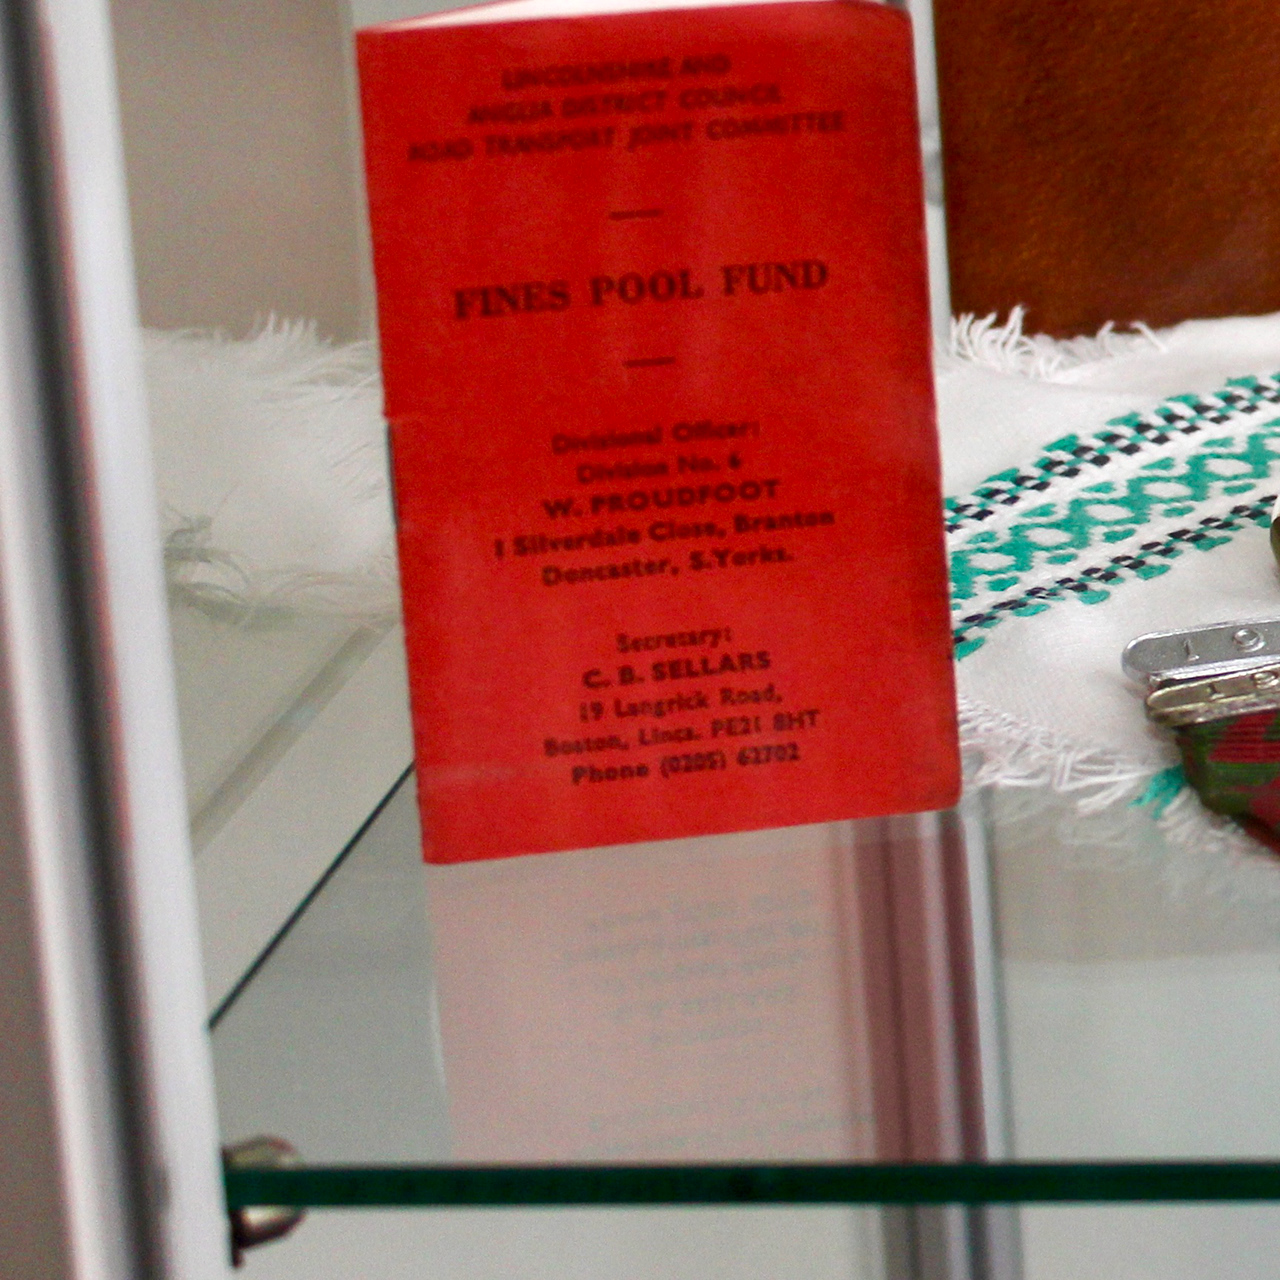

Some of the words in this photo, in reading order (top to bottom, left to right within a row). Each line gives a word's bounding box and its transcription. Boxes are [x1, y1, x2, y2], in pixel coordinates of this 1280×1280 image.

[680, 53, 732, 76] AND
[561, 89, 667, 117] DISTRICT
[679, 82, 783, 110] COUNCIL
[407, 137, 473, 162] ROAD
[485, 126, 615, 157] TRANSPORT
[628, 122, 694, 151] JOINT
[706, 110, 846, 140] COMMITTEE
[453, 281, 572, 320] FINES
[590, 271, 702, 306] POOL
[721, 260, 829, 296] FUND
[551, 426, 664, 455] Divisional
[577, 461, 669, 484] Division
[677, 455, 720, 474] No.
[543, 497, 582, 520] W.
[591, 479, 780, 515] PROUDFOOT
[512, 526, 640, 557] Silverdale
[648, 519, 726, 542] Close,
[734, 510, 836, 535] Branton
[541, 558, 680, 587] Doncaster,
[616, 627, 732, 653] Secretary:
[582, 669, 610, 689] C.
[618, 665, 644, 686] B.
[651, 651, 771, 682] SELLARS
[614, 691, 709, 718] Langrick
[720, 683, 783, 707] Road,
[571, 763, 649, 786] Phone
